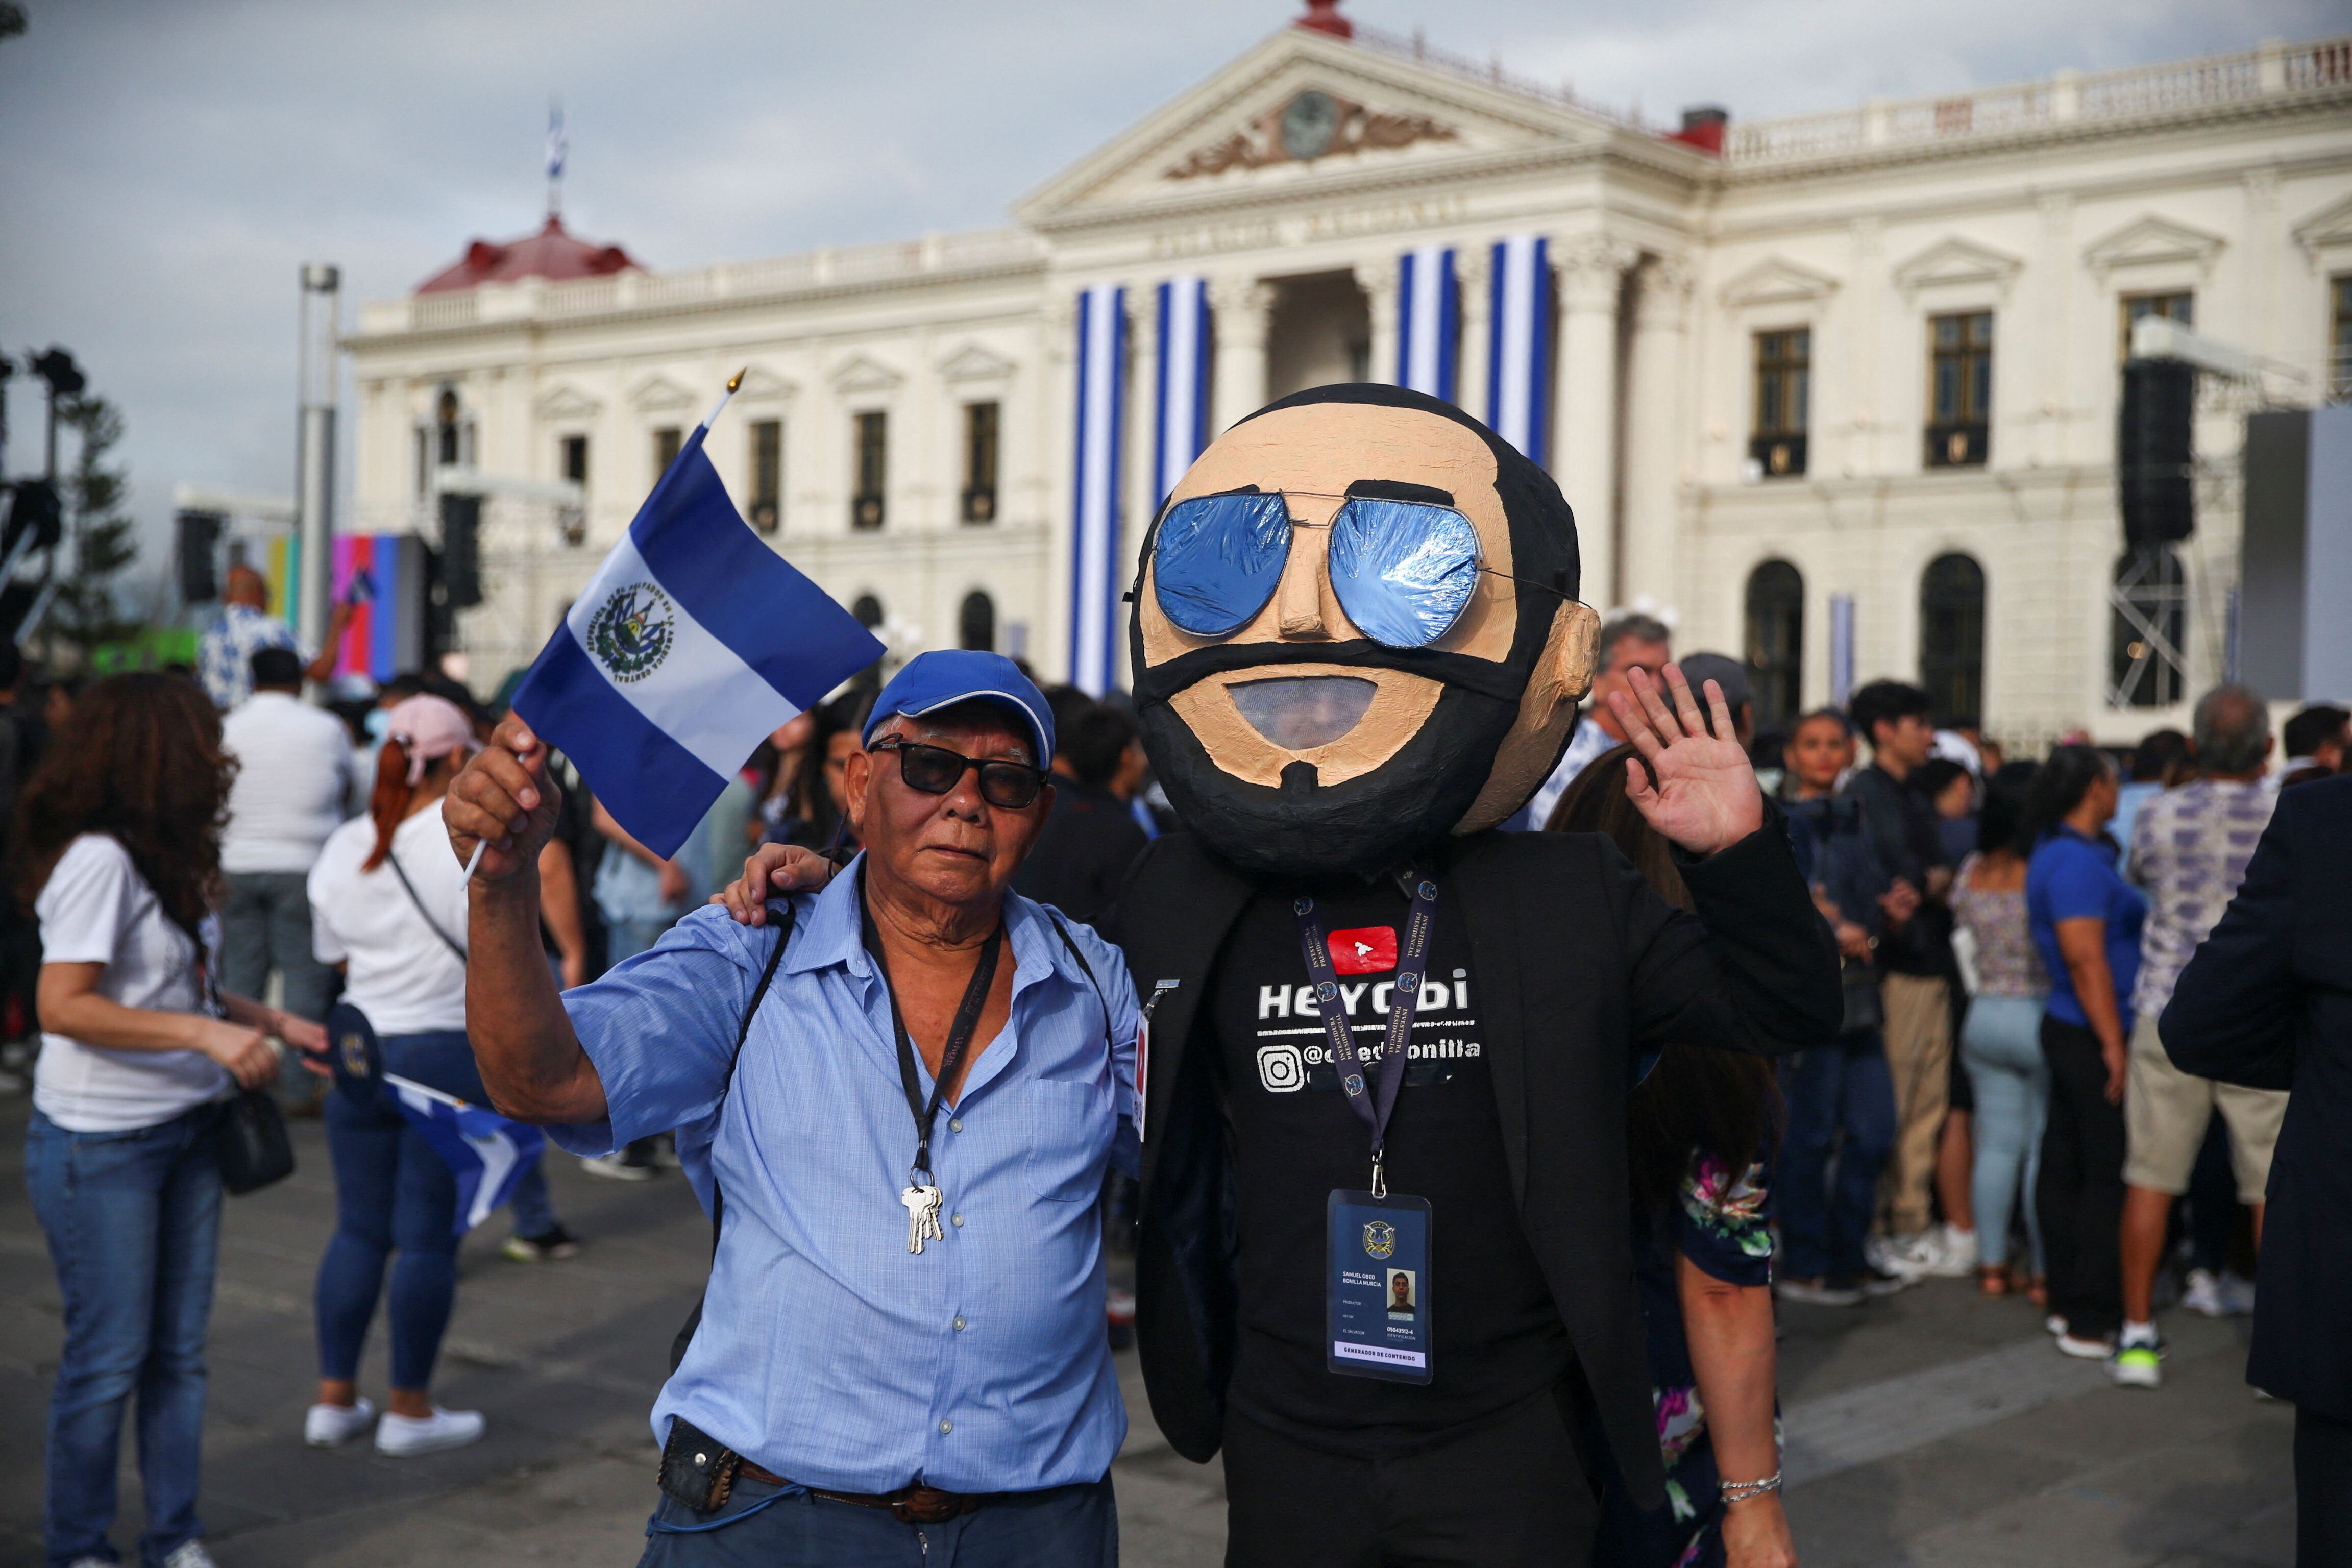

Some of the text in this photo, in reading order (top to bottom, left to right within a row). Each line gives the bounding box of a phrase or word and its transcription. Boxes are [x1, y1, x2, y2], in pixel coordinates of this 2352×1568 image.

[1407, 912, 1422, 958] PRESIDENCIAL
[1415, 915, 1429, 958] INVESTIDURA
[1329, 1017, 1344, 1061] INVESTIDURA
[1335, 1013, 1353, 1060] PRESIDENCIAL
[1388, 1006, 1402, 1055] PRESIDENCIAL
[1395, 1008, 1408, 1054] INVESTIDURA
[1387, 1327, 1413, 1335] 05043512-4
[1344, 1347, 1376, 1356] GENERADOR
[1385, 1353, 1415, 1361] CONTENIDO
